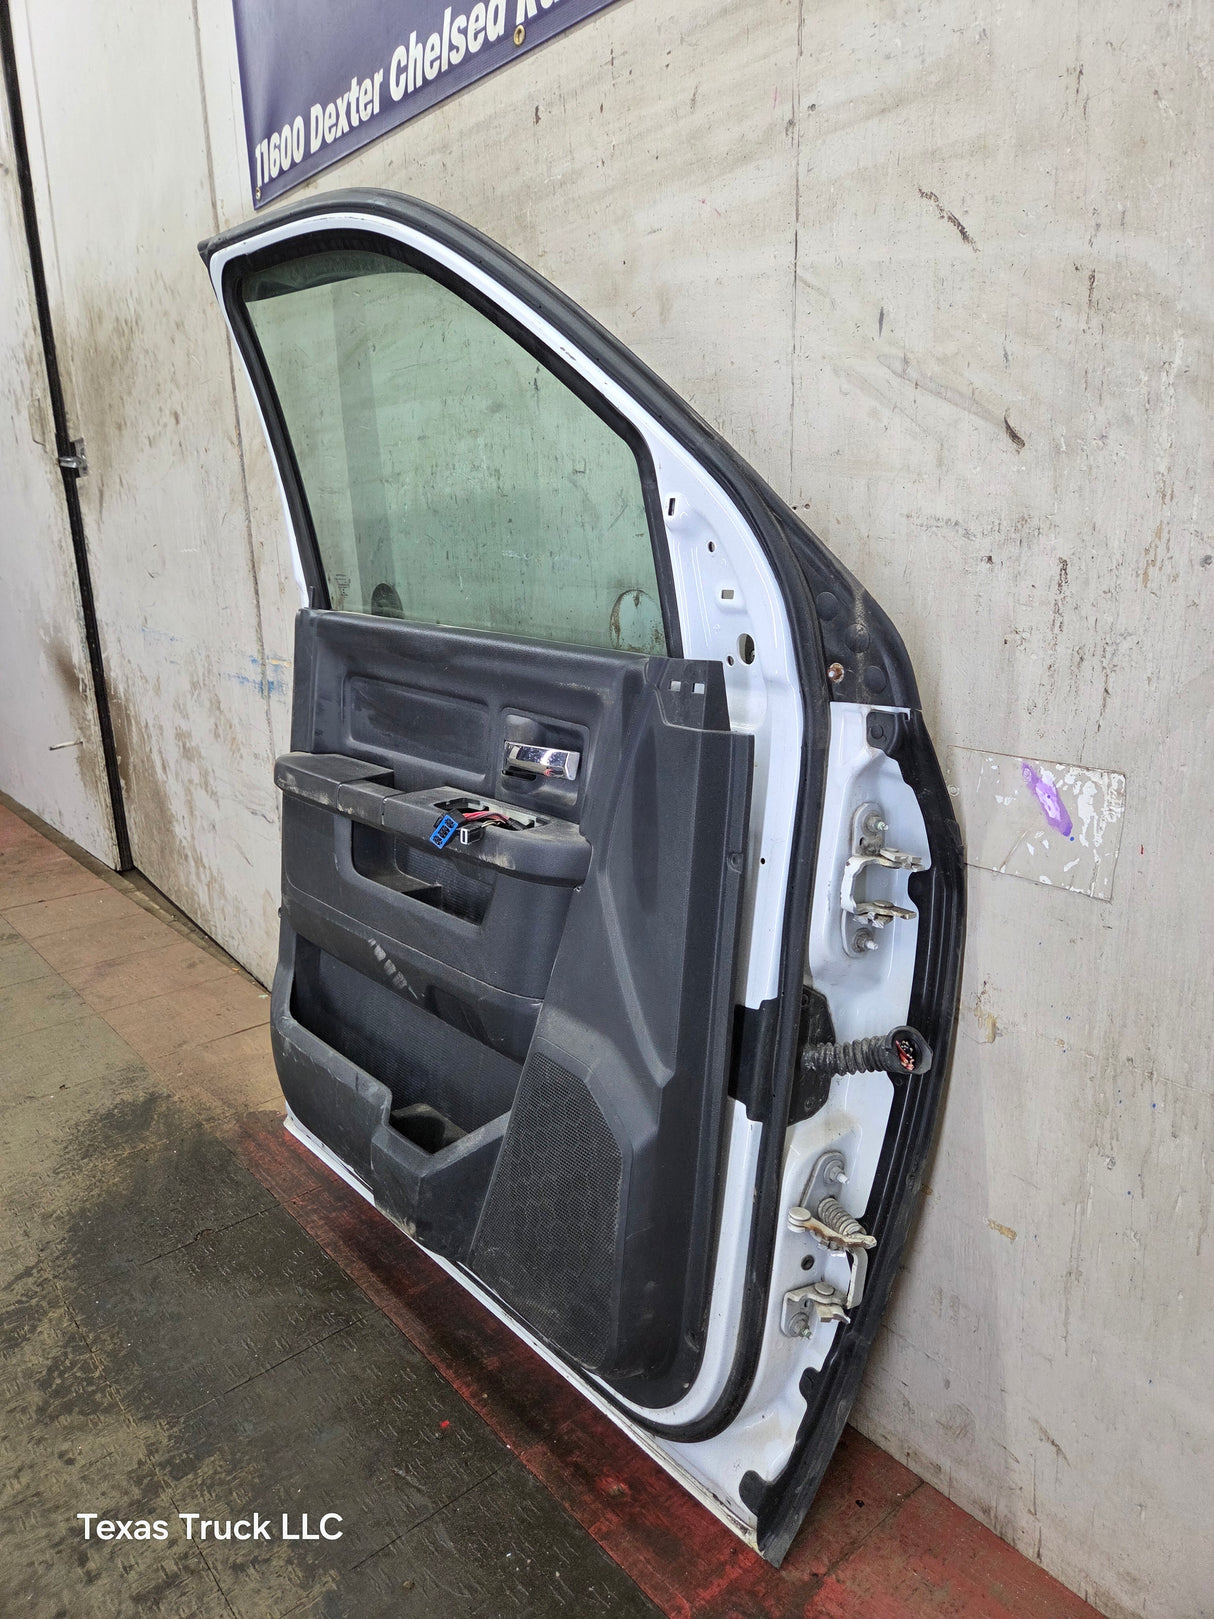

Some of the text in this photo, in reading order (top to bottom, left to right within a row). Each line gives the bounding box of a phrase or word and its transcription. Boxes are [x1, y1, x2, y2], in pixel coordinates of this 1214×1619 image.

[255, 0, 506, 186] 11600 Dexter Chelsea
